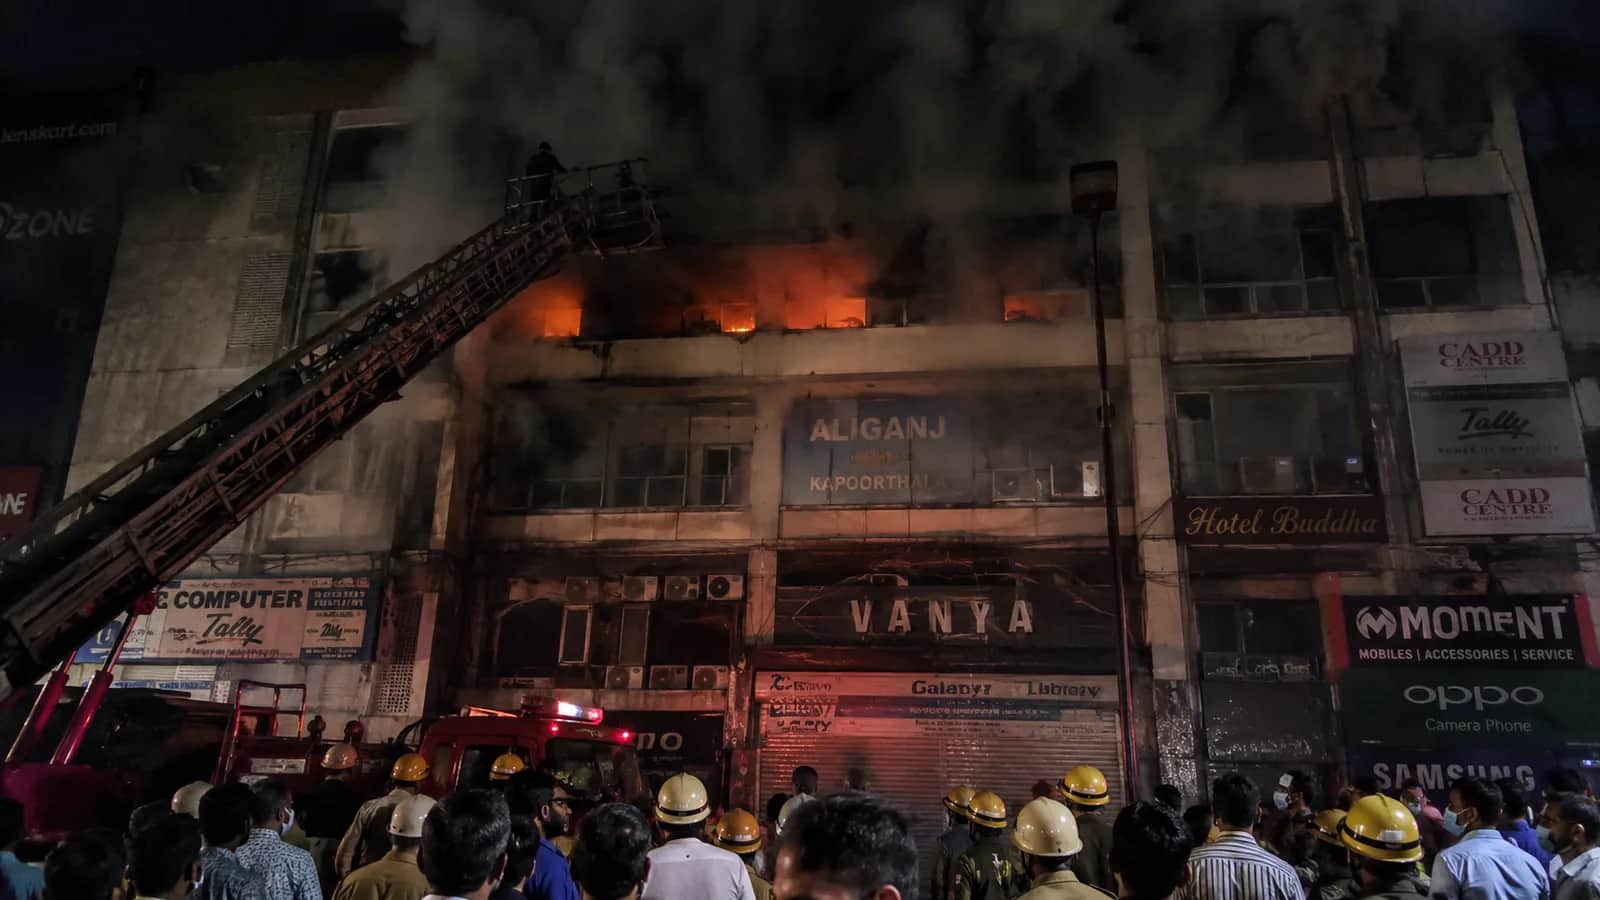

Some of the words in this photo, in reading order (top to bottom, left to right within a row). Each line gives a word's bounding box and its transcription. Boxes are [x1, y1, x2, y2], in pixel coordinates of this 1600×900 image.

[1438, 341, 1524, 358] CADD
[1440, 356, 1526, 368] CENTRE
[809, 416, 946, 442] ALIGANJ
[1460, 407, 1531, 439] Tally
[0, 493, 28, 515] NE
[1460, 487, 1550, 505] CADD
[1463, 503, 1552, 516] CENTRE
[1185, 506, 1264, 535] Hotel
[1270, 506, 1377, 535] Buddha
[174, 590, 304, 609] COMPUTER
[850, 599, 1033, 633] VANYA
[200, 613, 264, 645] Tally
[1359, 648, 1413, 661] MOBILES
[1424, 648, 1510, 661] ACCESSORIES
[1521, 648, 1575, 661] SERVICE
[1403, 685, 1544, 711] oppo
[1425, 718, 1481, 732] Camera
[1486, 718, 1532, 733] Phone
